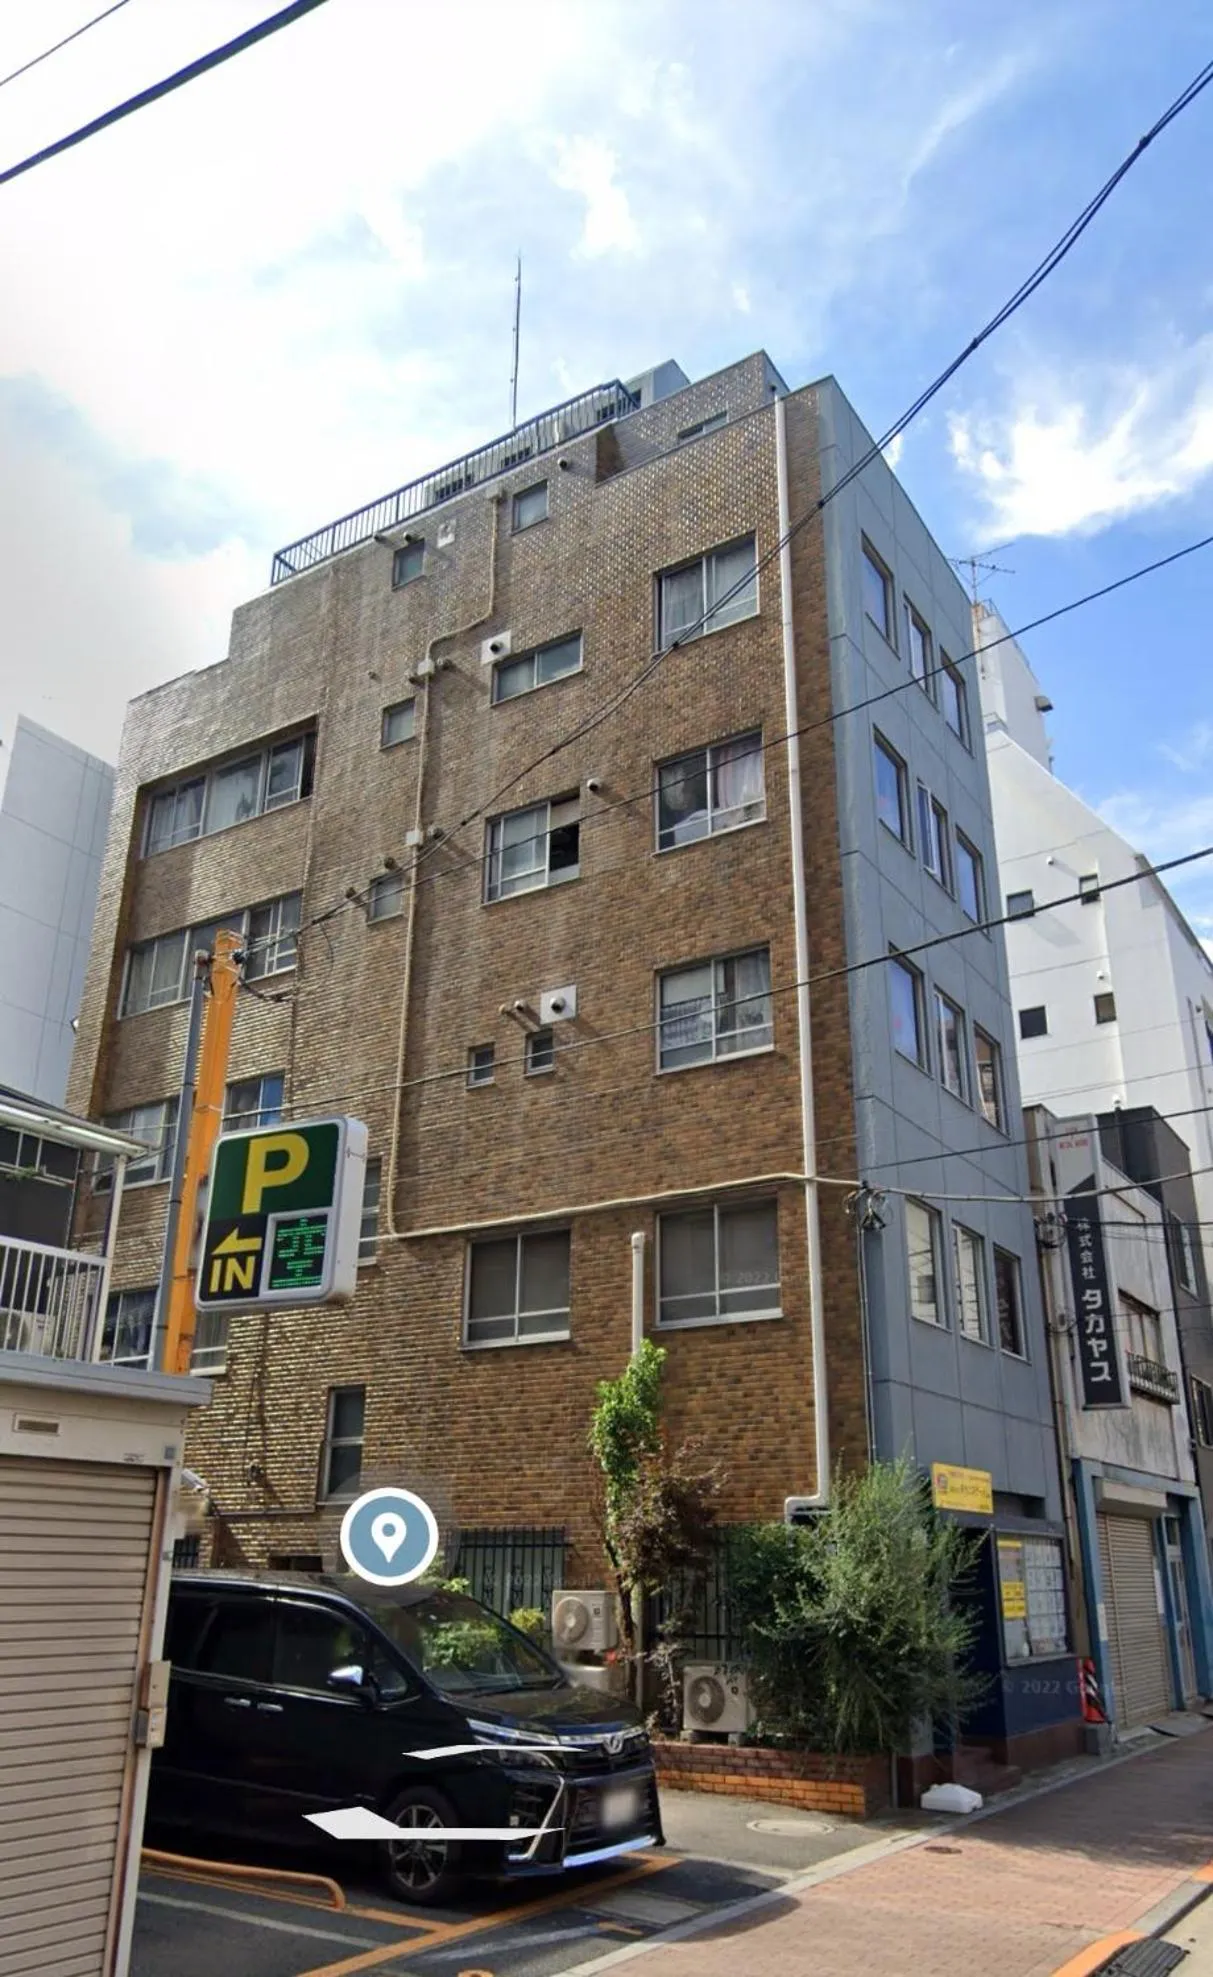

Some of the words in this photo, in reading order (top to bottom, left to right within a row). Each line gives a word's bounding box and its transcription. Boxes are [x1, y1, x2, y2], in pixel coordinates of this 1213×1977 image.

[242, 1132, 310, 1215] P
[209, 1255, 256, 1294] IN
[271, 1216, 328, 1289] 空
[1081, 1288, 1112, 1383] タカヤス
